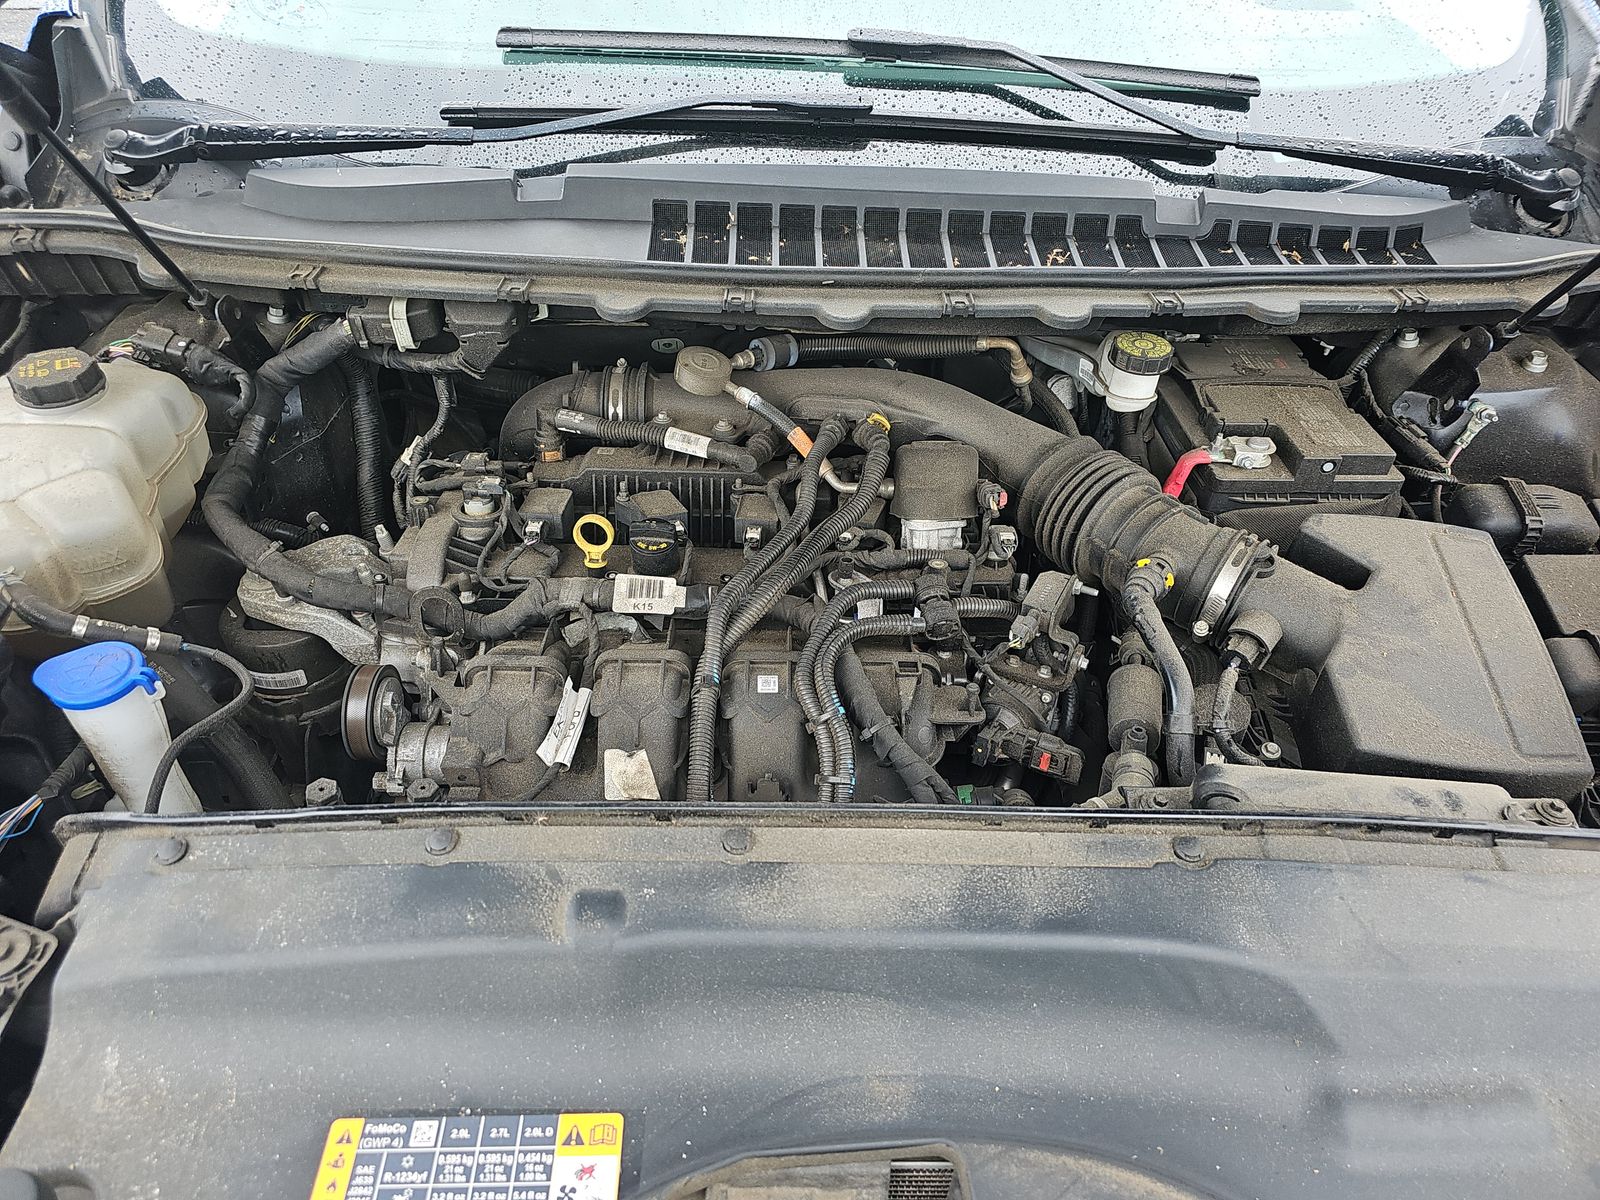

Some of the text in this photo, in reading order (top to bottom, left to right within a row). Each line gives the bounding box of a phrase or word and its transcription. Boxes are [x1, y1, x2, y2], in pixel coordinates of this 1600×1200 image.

[633, 602, 654, 611] K15
[365, 1123, 408, 1135] FoMoCo
[450, 1128, 471, 1139] 2.0L
[490, 1127, 511, 1138] 2.7L
[524, 1126, 544, 1138] 2.0L
[360, 1136, 405, 1150] (GWP 4)
[462, 1153, 474, 1168] kg
[502, 1153, 514, 1167] kg
[541, 1152, 553, 1166] kg
[355, 1165, 376, 1176] SAE
[443, 1165, 465, 1175] 21 oz
[484, 1164, 505, 1174] 21 oz
[534, 1164, 545, 1173] oz
[383, 1171, 428, 1184] R-1234yf
